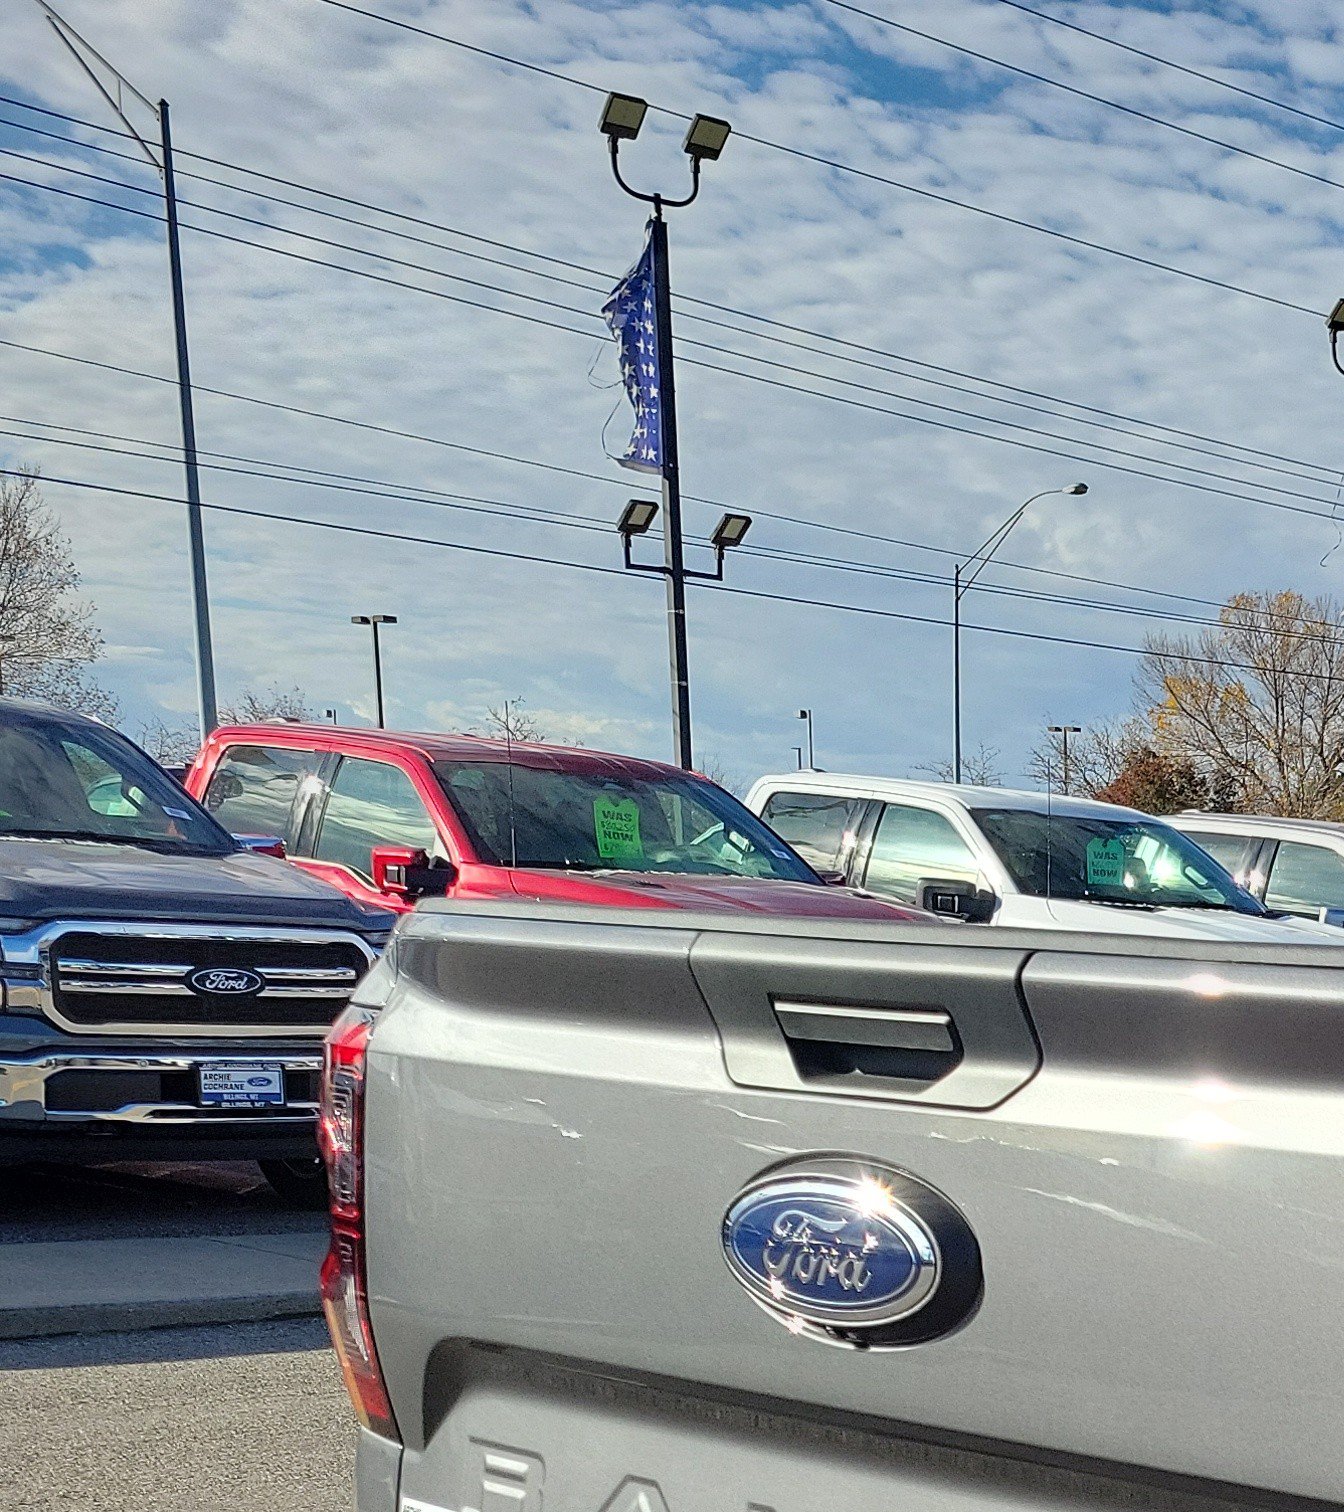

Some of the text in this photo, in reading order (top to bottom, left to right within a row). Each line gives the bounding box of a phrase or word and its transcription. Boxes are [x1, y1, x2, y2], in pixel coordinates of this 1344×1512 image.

[602, 810, 632, 822] WAS
[603, 831, 633, 842] NOW
[205, 971, 248, 990] Ford
[762, 1209, 873, 1293] Ford
